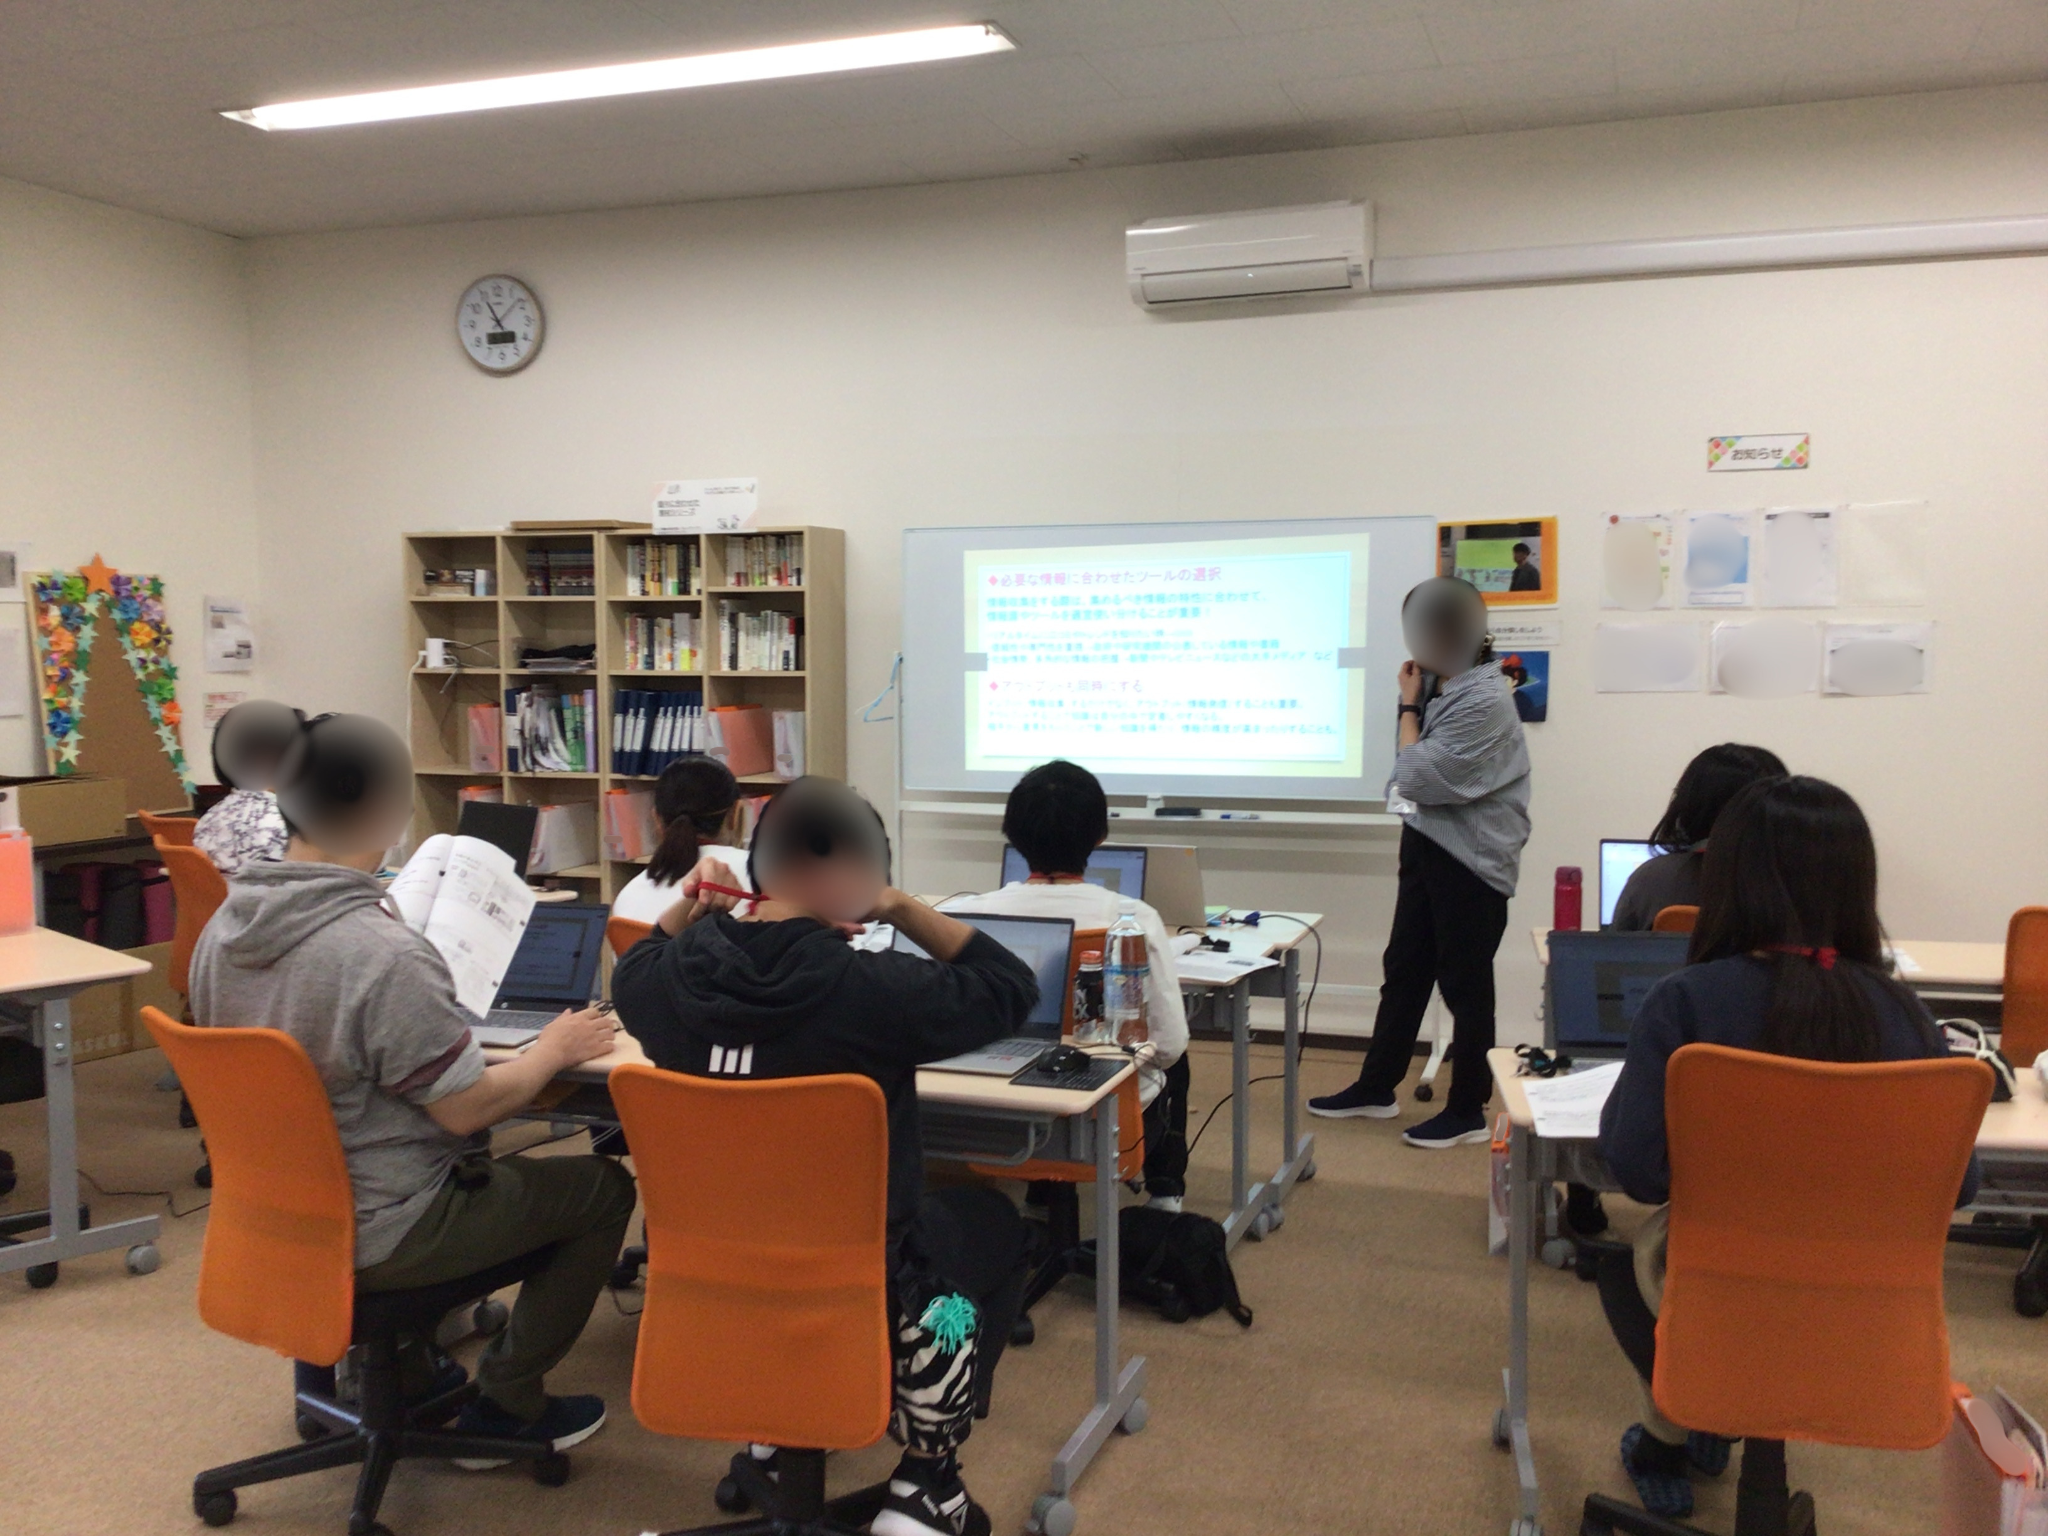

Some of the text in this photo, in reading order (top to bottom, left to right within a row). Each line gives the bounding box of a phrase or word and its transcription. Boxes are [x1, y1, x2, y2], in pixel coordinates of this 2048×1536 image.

[1730, 447, 1785, 461] お知らせ
[1000, 567, 1222, 587] 必要な情報に合わせたツールの選択
